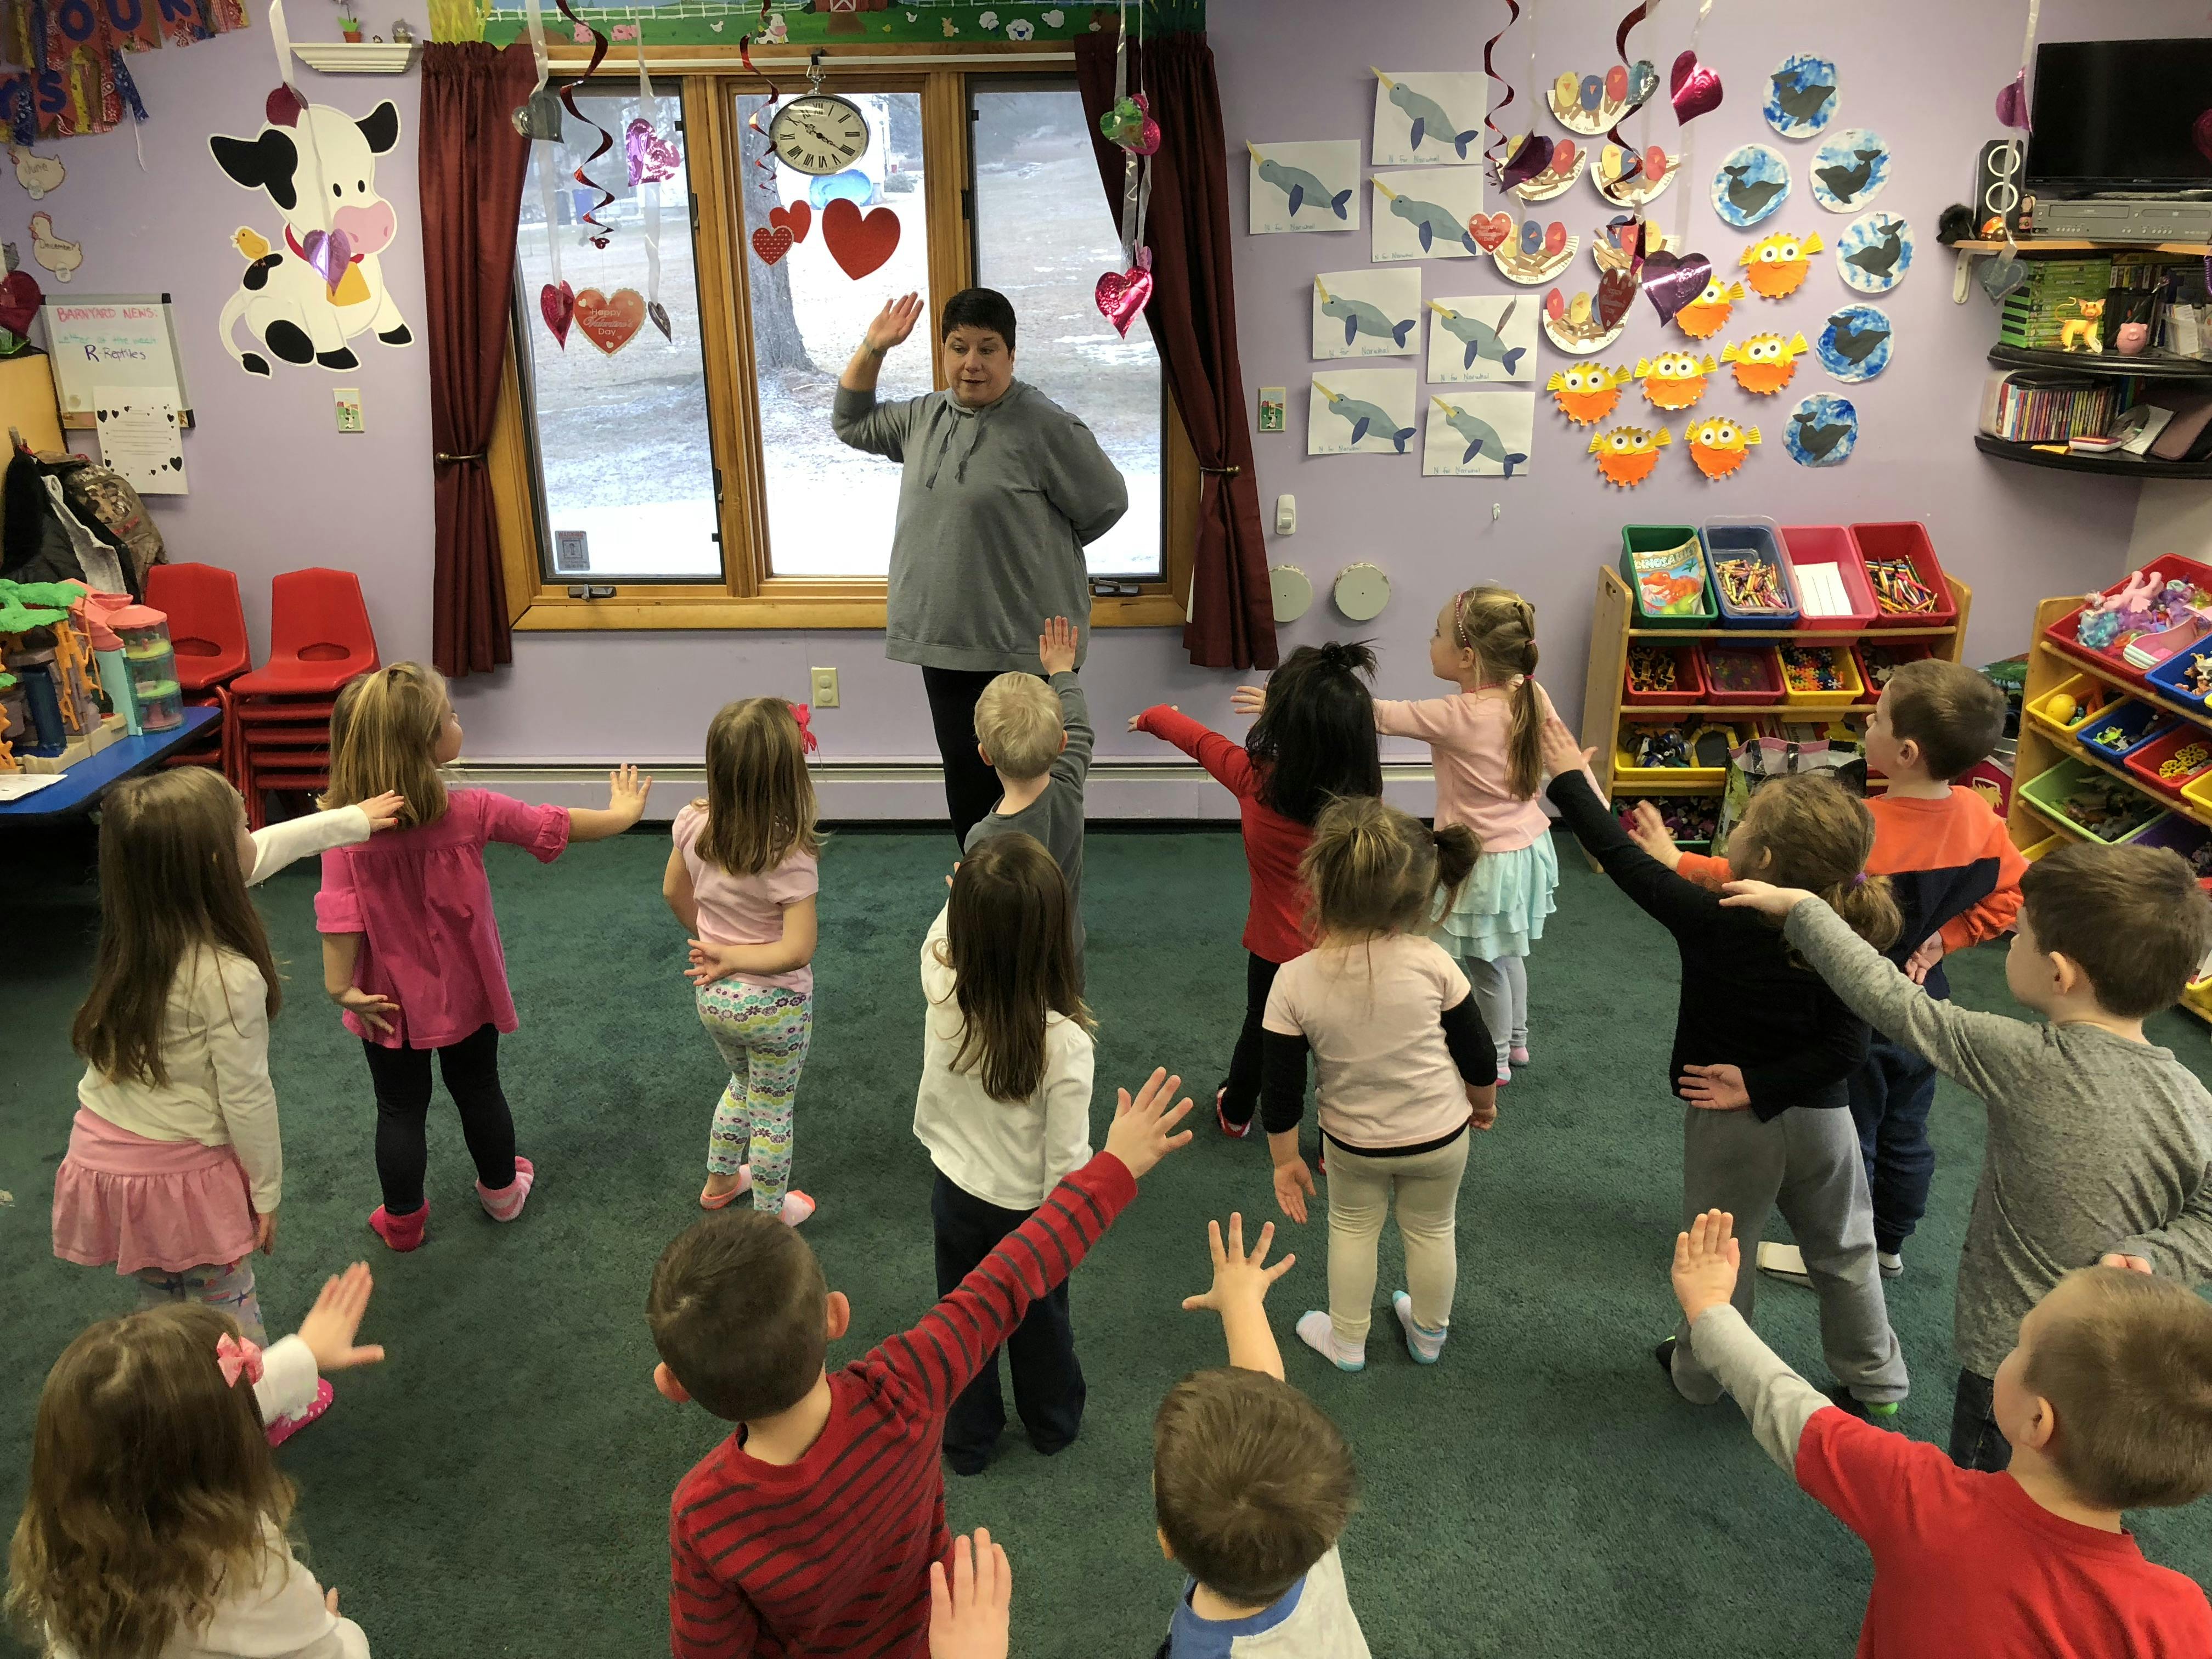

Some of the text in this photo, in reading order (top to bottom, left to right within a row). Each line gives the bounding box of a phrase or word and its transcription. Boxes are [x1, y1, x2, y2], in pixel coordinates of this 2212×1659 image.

[57, 307, 116, 322] BARNYARD
[591, 308, 621, 317] Happy
[598, 328, 616, 336] Day
